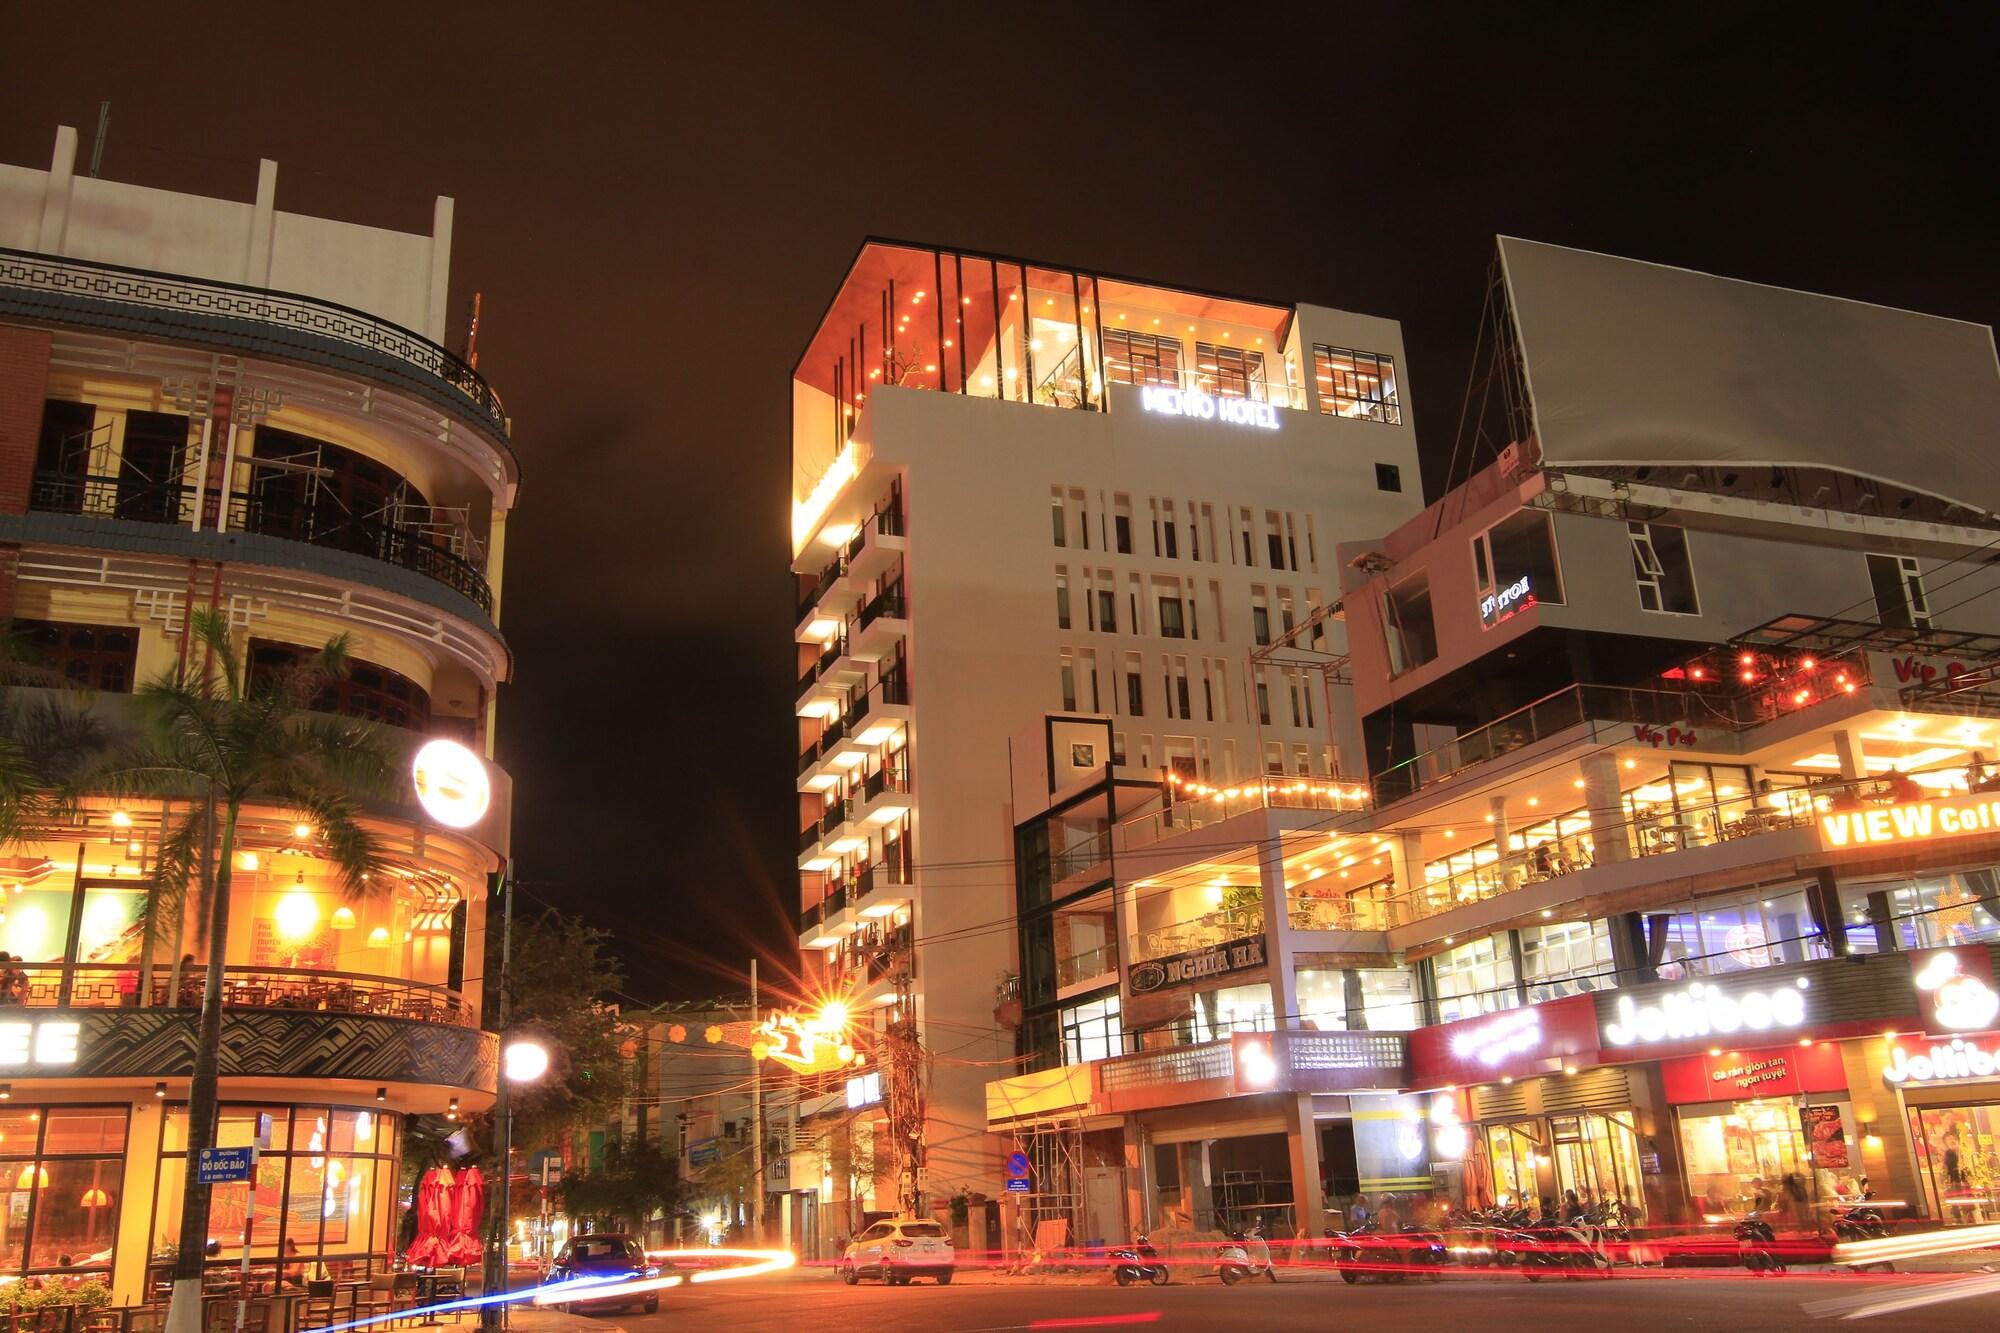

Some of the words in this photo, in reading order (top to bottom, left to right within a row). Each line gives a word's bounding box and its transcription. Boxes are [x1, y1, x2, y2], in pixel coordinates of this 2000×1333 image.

[1218, 397, 1280, 429] HOTEL
[1892, 656, 1937, 688] Vip
[1633, 724, 1664, 748] Vip
[1823, 804, 1932, 845] VIEW
[1166, 948, 1230, 983] NGHĨA
[1232, 939, 1264, 969] HÀ
[1606, 982, 1804, 1045] Jollibee
[1736, 1075, 1760, 1088] ngon
[1762, 1067, 1787, 1080] tuyệt
